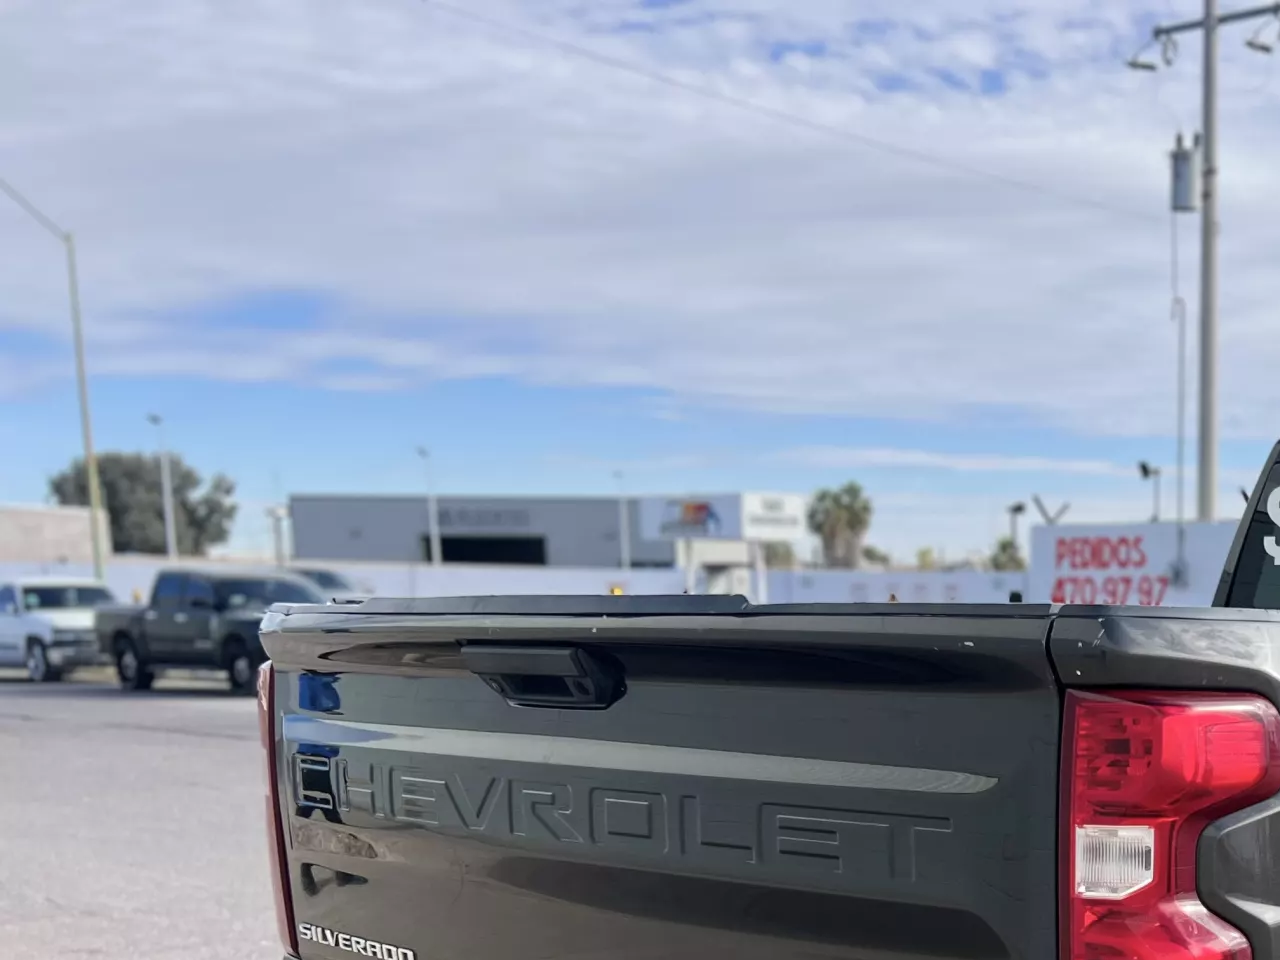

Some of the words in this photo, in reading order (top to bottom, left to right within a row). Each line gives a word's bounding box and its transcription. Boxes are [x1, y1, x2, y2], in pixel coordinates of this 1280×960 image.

[1055, 535, 1148, 570] PEDIDOS
[1050, 576, 1099, 606] 470
[1102, 576, 1135, 606] 97
[1137, 575, 1170, 606] 97
[291, 753, 955, 884] CHEVROLET
